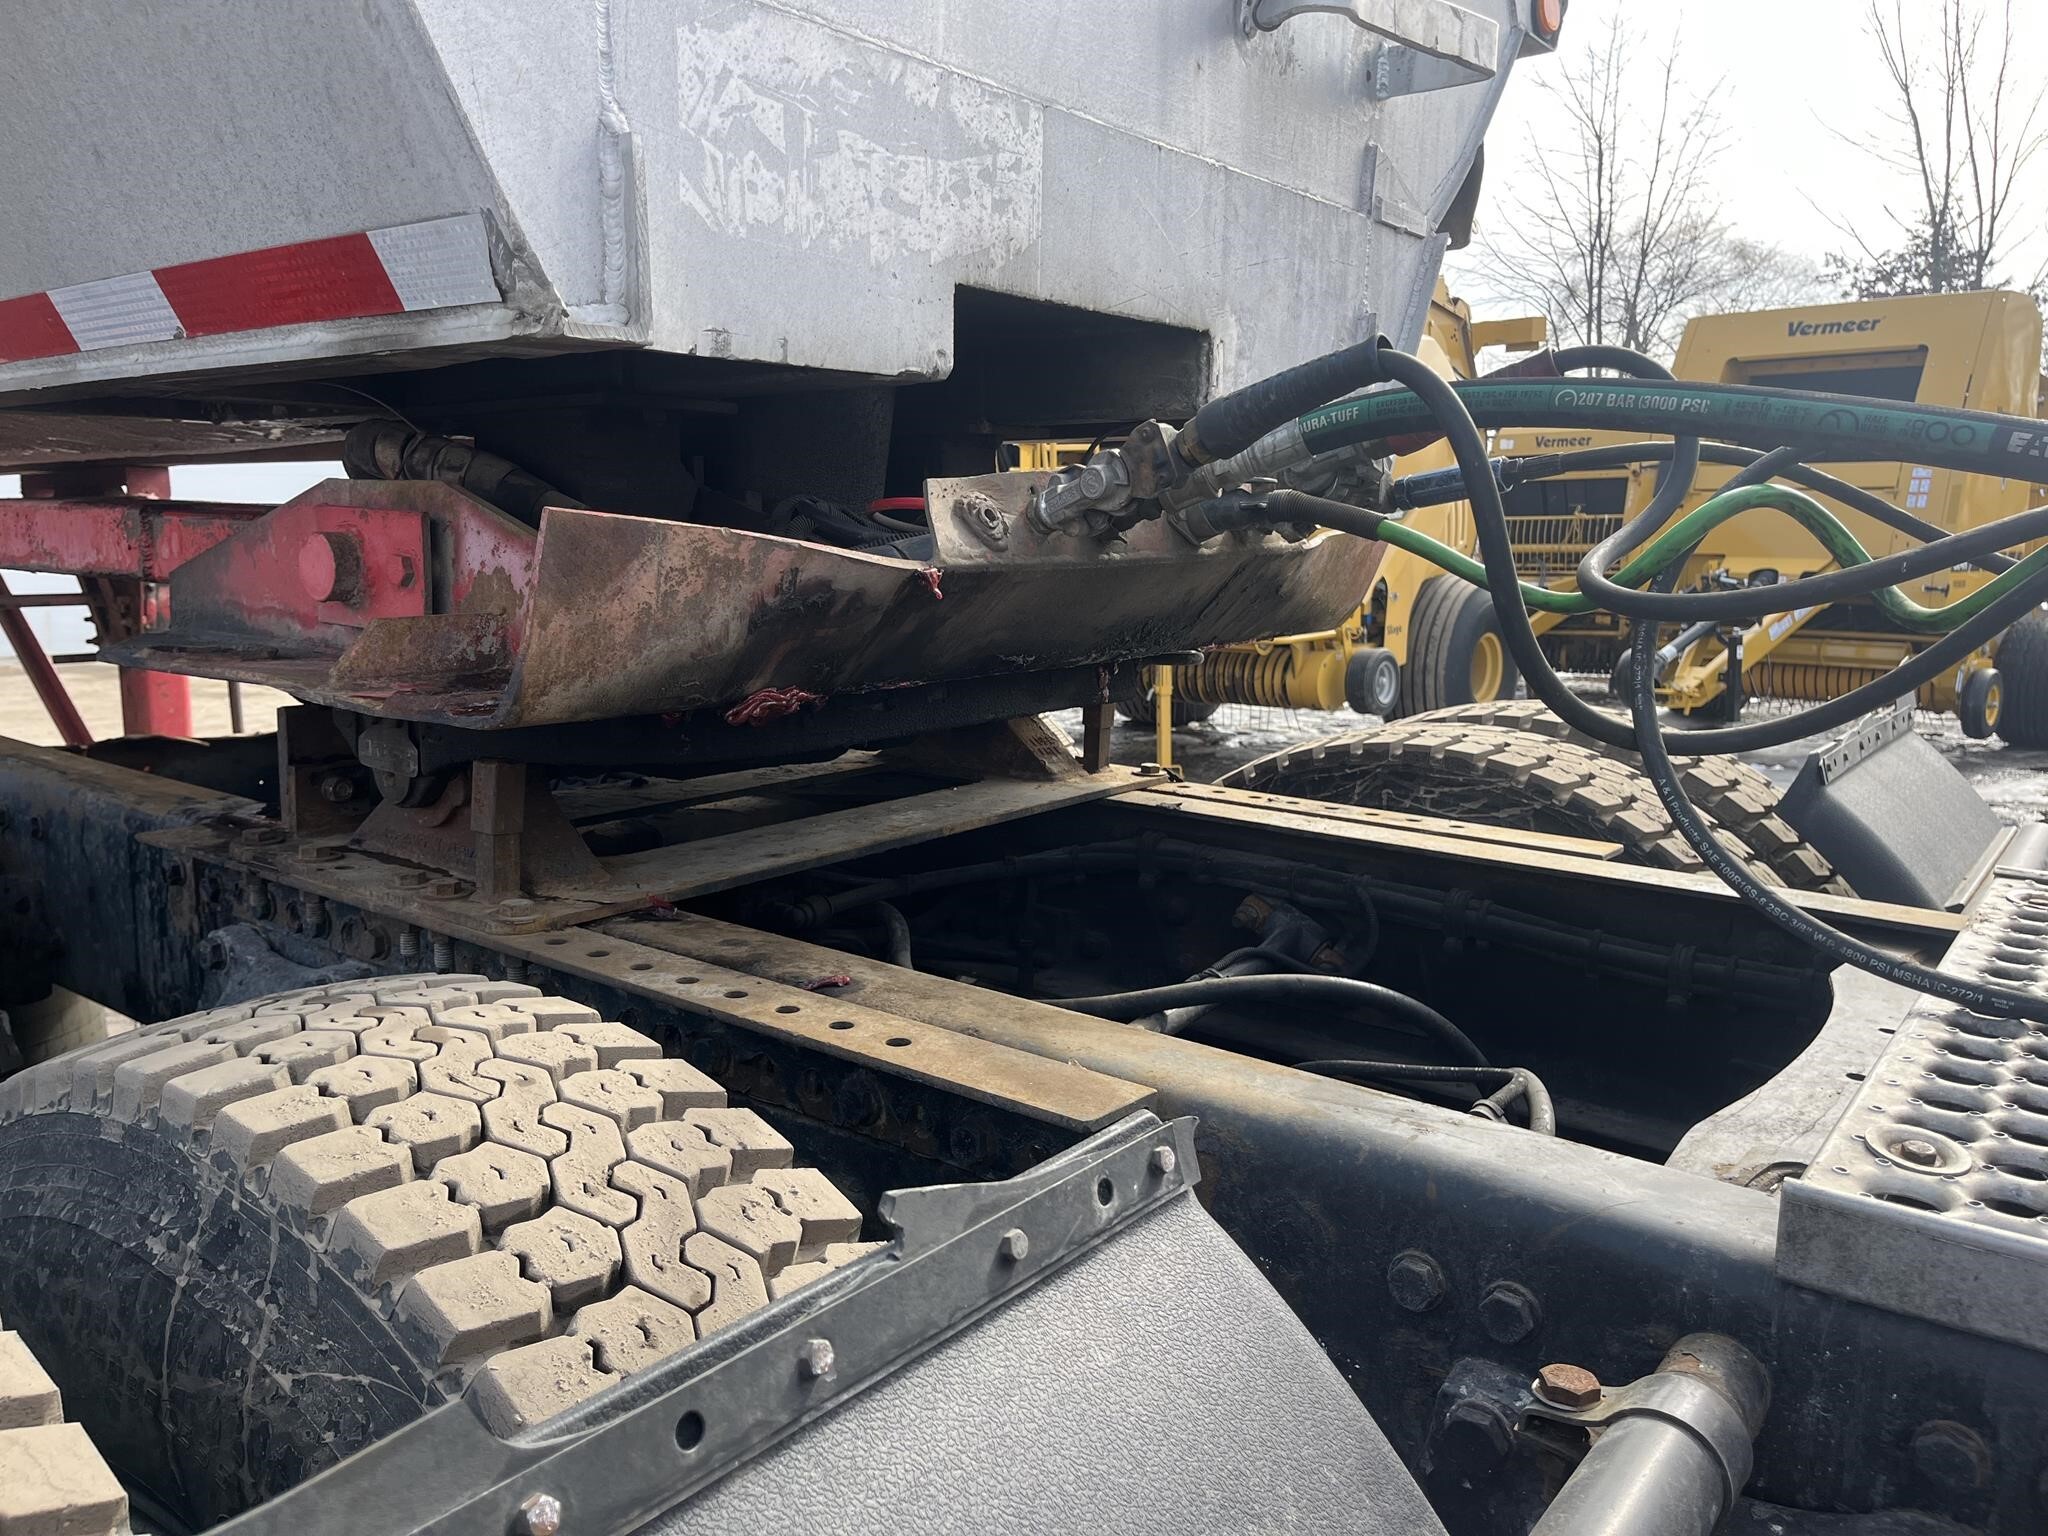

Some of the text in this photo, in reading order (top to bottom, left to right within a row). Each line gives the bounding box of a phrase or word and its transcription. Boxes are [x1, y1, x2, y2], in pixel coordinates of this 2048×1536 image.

[1788, 317, 1881, 337] Vermeer
[1578, 392, 1601, 406] 207
[1606, 393, 1635, 408] BAR
[1638, 394, 1677, 411] (3000
[1535, 436, 1592, 448] Vermeer
[1669, 801, 1700, 843] Products
[1700, 842, 1720, 863] SAE
[1766, 902, 1789, 921] 2SC
[1869, 958, 1890, 974] PSI
[1892, 967, 1930, 989] MSHA
